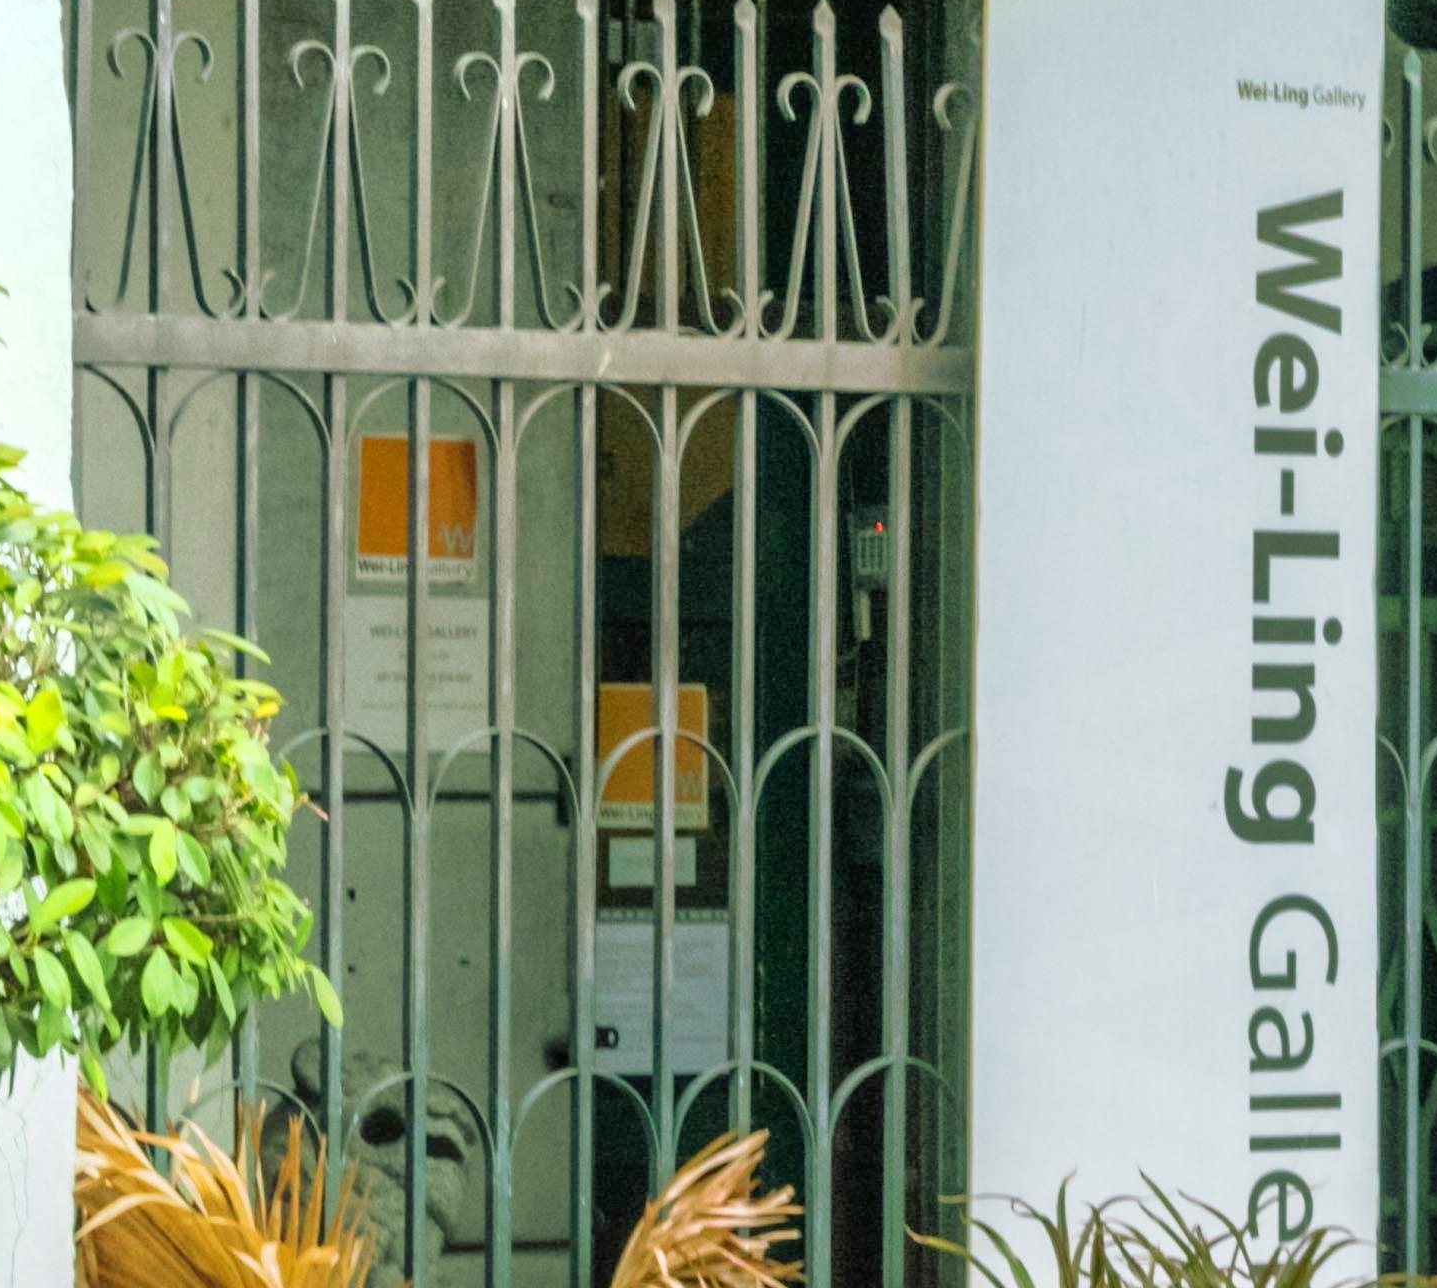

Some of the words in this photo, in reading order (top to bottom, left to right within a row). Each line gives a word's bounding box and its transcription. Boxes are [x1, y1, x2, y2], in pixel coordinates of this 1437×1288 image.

[1236, 78, 1309, 110] Wei-Ling
[1313, 84, 1367, 112] Gallery
[1223, 188, 1344, 847] Wei-Ling
